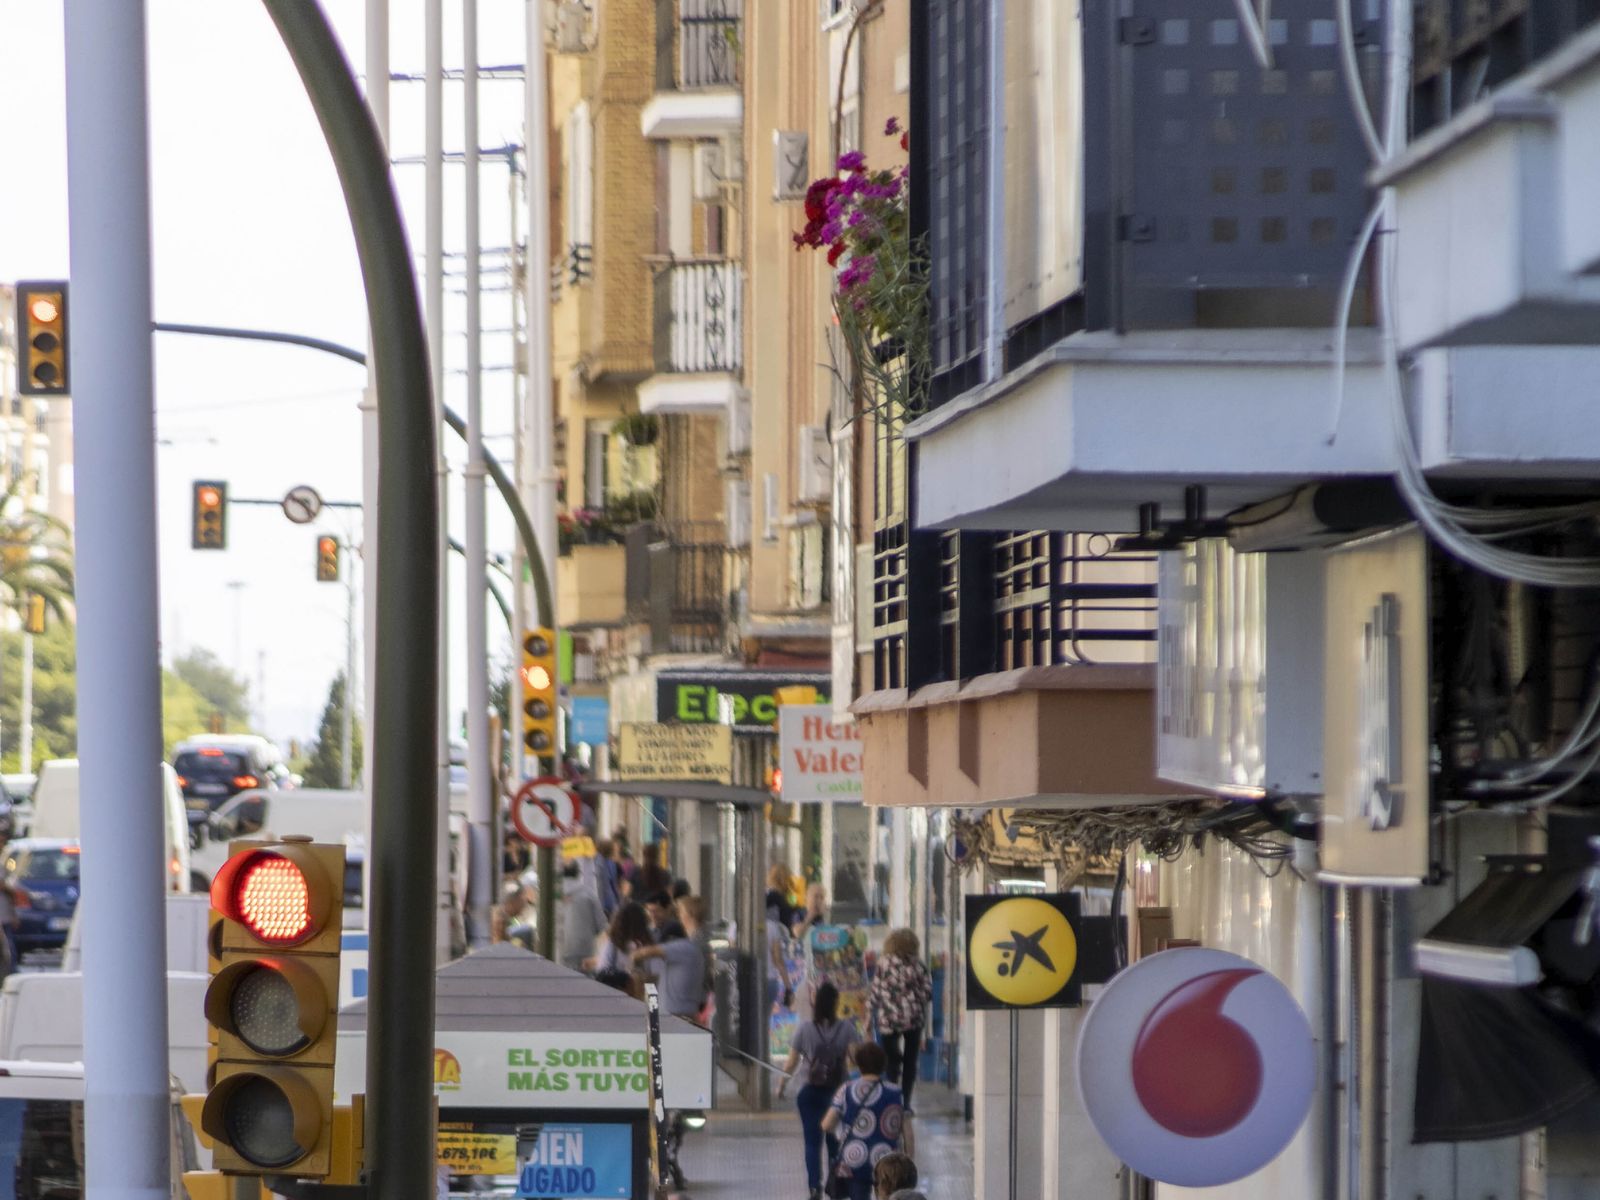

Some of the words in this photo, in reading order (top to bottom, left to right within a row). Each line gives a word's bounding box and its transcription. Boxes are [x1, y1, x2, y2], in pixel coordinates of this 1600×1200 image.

[507, 1048, 542, 1067] EL
[545, 1048, 649, 1068] SORTEO
[507, 1067, 570, 1092] MÁS
[575, 1072, 650, 1093] TUYO
